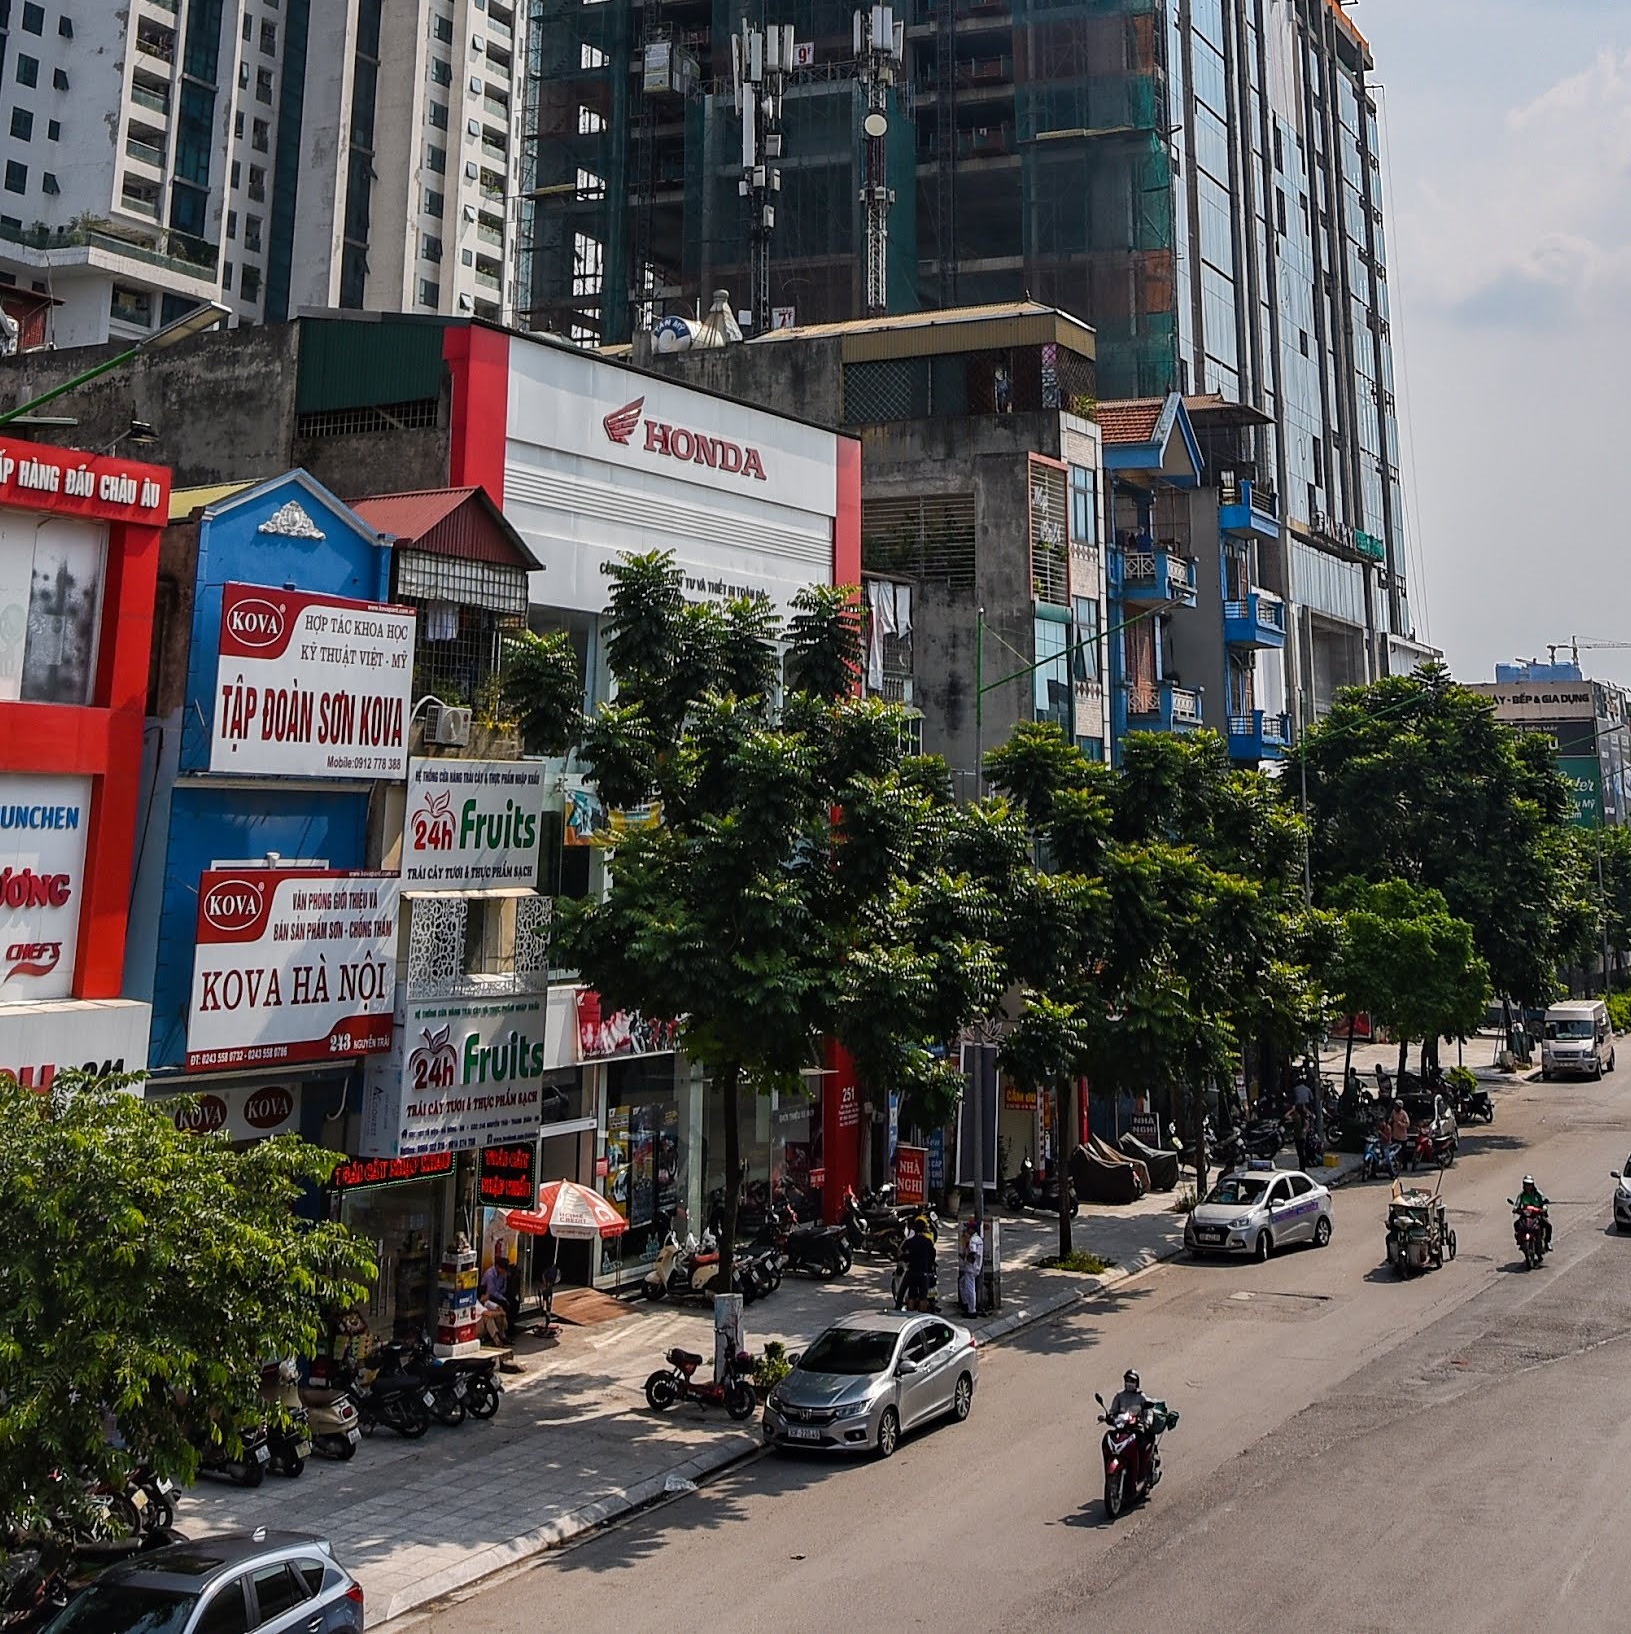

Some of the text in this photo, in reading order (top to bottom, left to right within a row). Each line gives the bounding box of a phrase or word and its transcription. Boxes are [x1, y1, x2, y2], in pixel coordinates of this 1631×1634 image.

[644, 419, 767, 480] HONDA
[19, 457, 60, 493] HÀNG
[100, 473, 137, 505] CHÂU
[140, 478, 161, 509] ÂU
[232, 611, 279, 634] KOVA
[305, 614, 408, 644] HỢP TÁC KHOA HỌC
[320, 644, 357, 669] THUẬT
[360, 647, 383, 671] VIỆT
[1542, 694, 1559, 704] GIA
[1561, 693, 1589, 705] DỤNG
[221, 674, 403, 753] TẬP ĐOÀN SƠN KOVA
[414, 820, 453, 851] 24h
[407, 863, 426, 880] TRÁI
[427, 864, 444, 881] CÂY
[445, 865, 463, 880] TƯƠI
[471, 865, 491, 882] THỰC
[492, 860, 513, 878] PHẨM
[514, 865, 532, 880] SẠCH
[209, 895, 257, 916] KOVA
[292, 890, 307, 911] VĂN
[308, 889, 332, 910] PHÒNG
[349, 890, 368, 914] THIỆU
[273, 919, 289, 941] BÁN
[290, 916, 306, 941] SẢN
[199, 949, 387, 1012] KOVA HÀ NỘI
[329, 1033, 351, 1052] 243
[414, 1058, 454, 1089] 24h
[842, 1086, 855, 1102] 251
[178, 1104, 222, 1128] KOVA
[247, 1096, 289, 1120] KOVA
[899, 1159, 920, 1175] NHÀ
